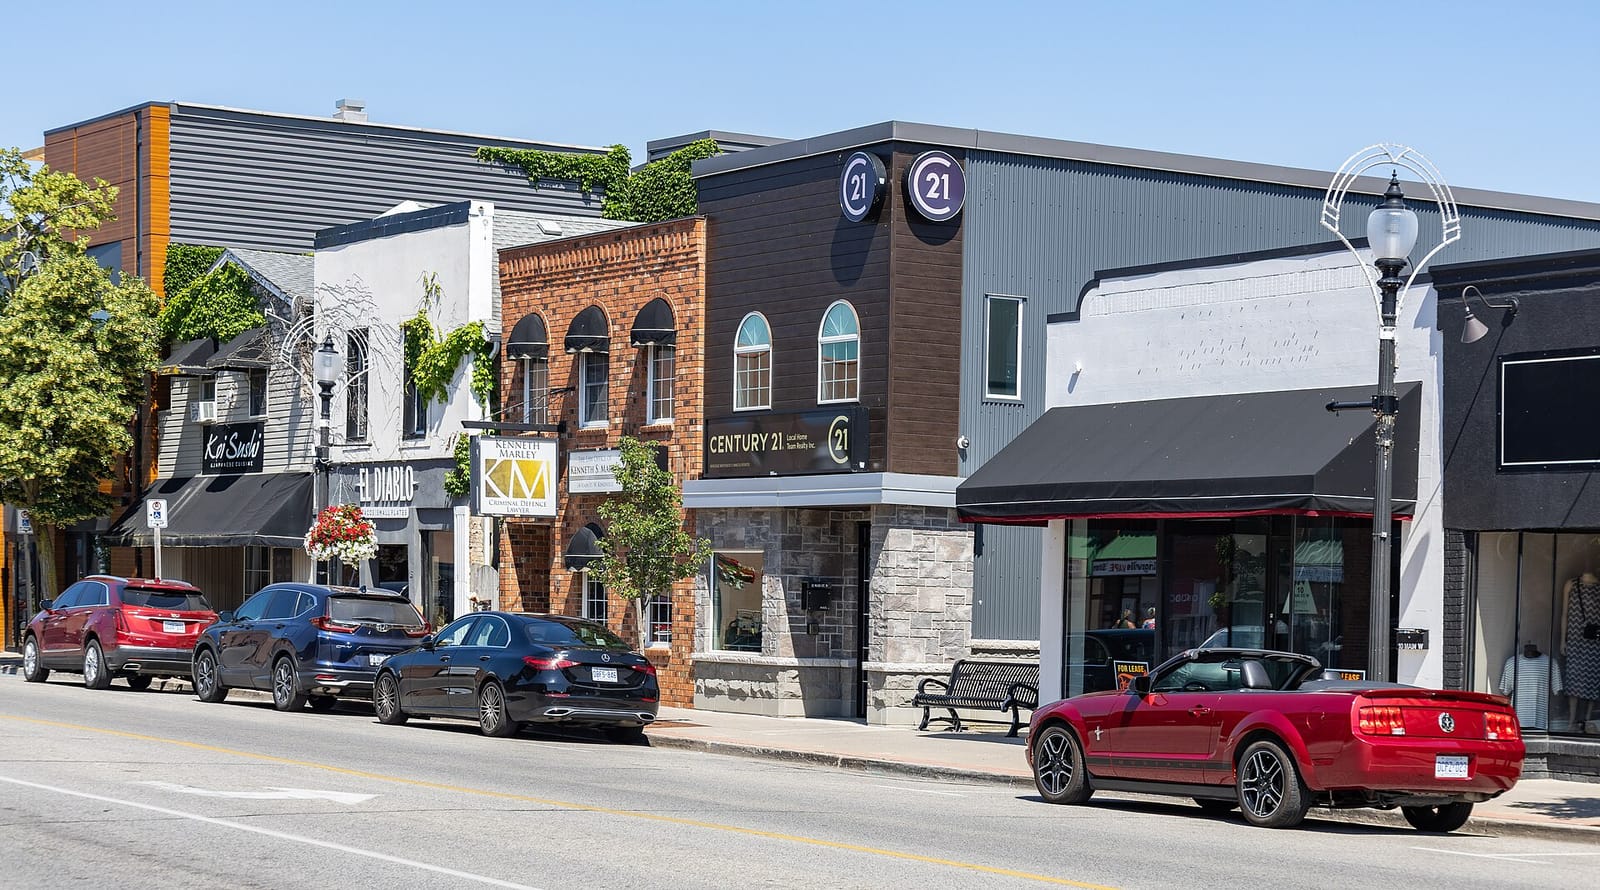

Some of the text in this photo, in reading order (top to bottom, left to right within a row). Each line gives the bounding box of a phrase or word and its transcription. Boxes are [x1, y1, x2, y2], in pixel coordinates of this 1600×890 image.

[786, 433, 808, 441] Local Home
[204, 429, 262, 460] Koi Sushi
[495, 439, 540, 450] KENNETH
[710, 432, 783, 454] CENTURY 21
[786, 442, 796, 450] Team
[796, 442, 808, 450] Realty
[500, 449, 537, 459] MARLEY
[571, 465, 595, 475] KENNETH
[358, 465, 416, 502] EL DIABLO
[488, 499, 547, 508] CRIMINAL DEFENCE
[1117, 664, 1145, 673] FOR LEASE
